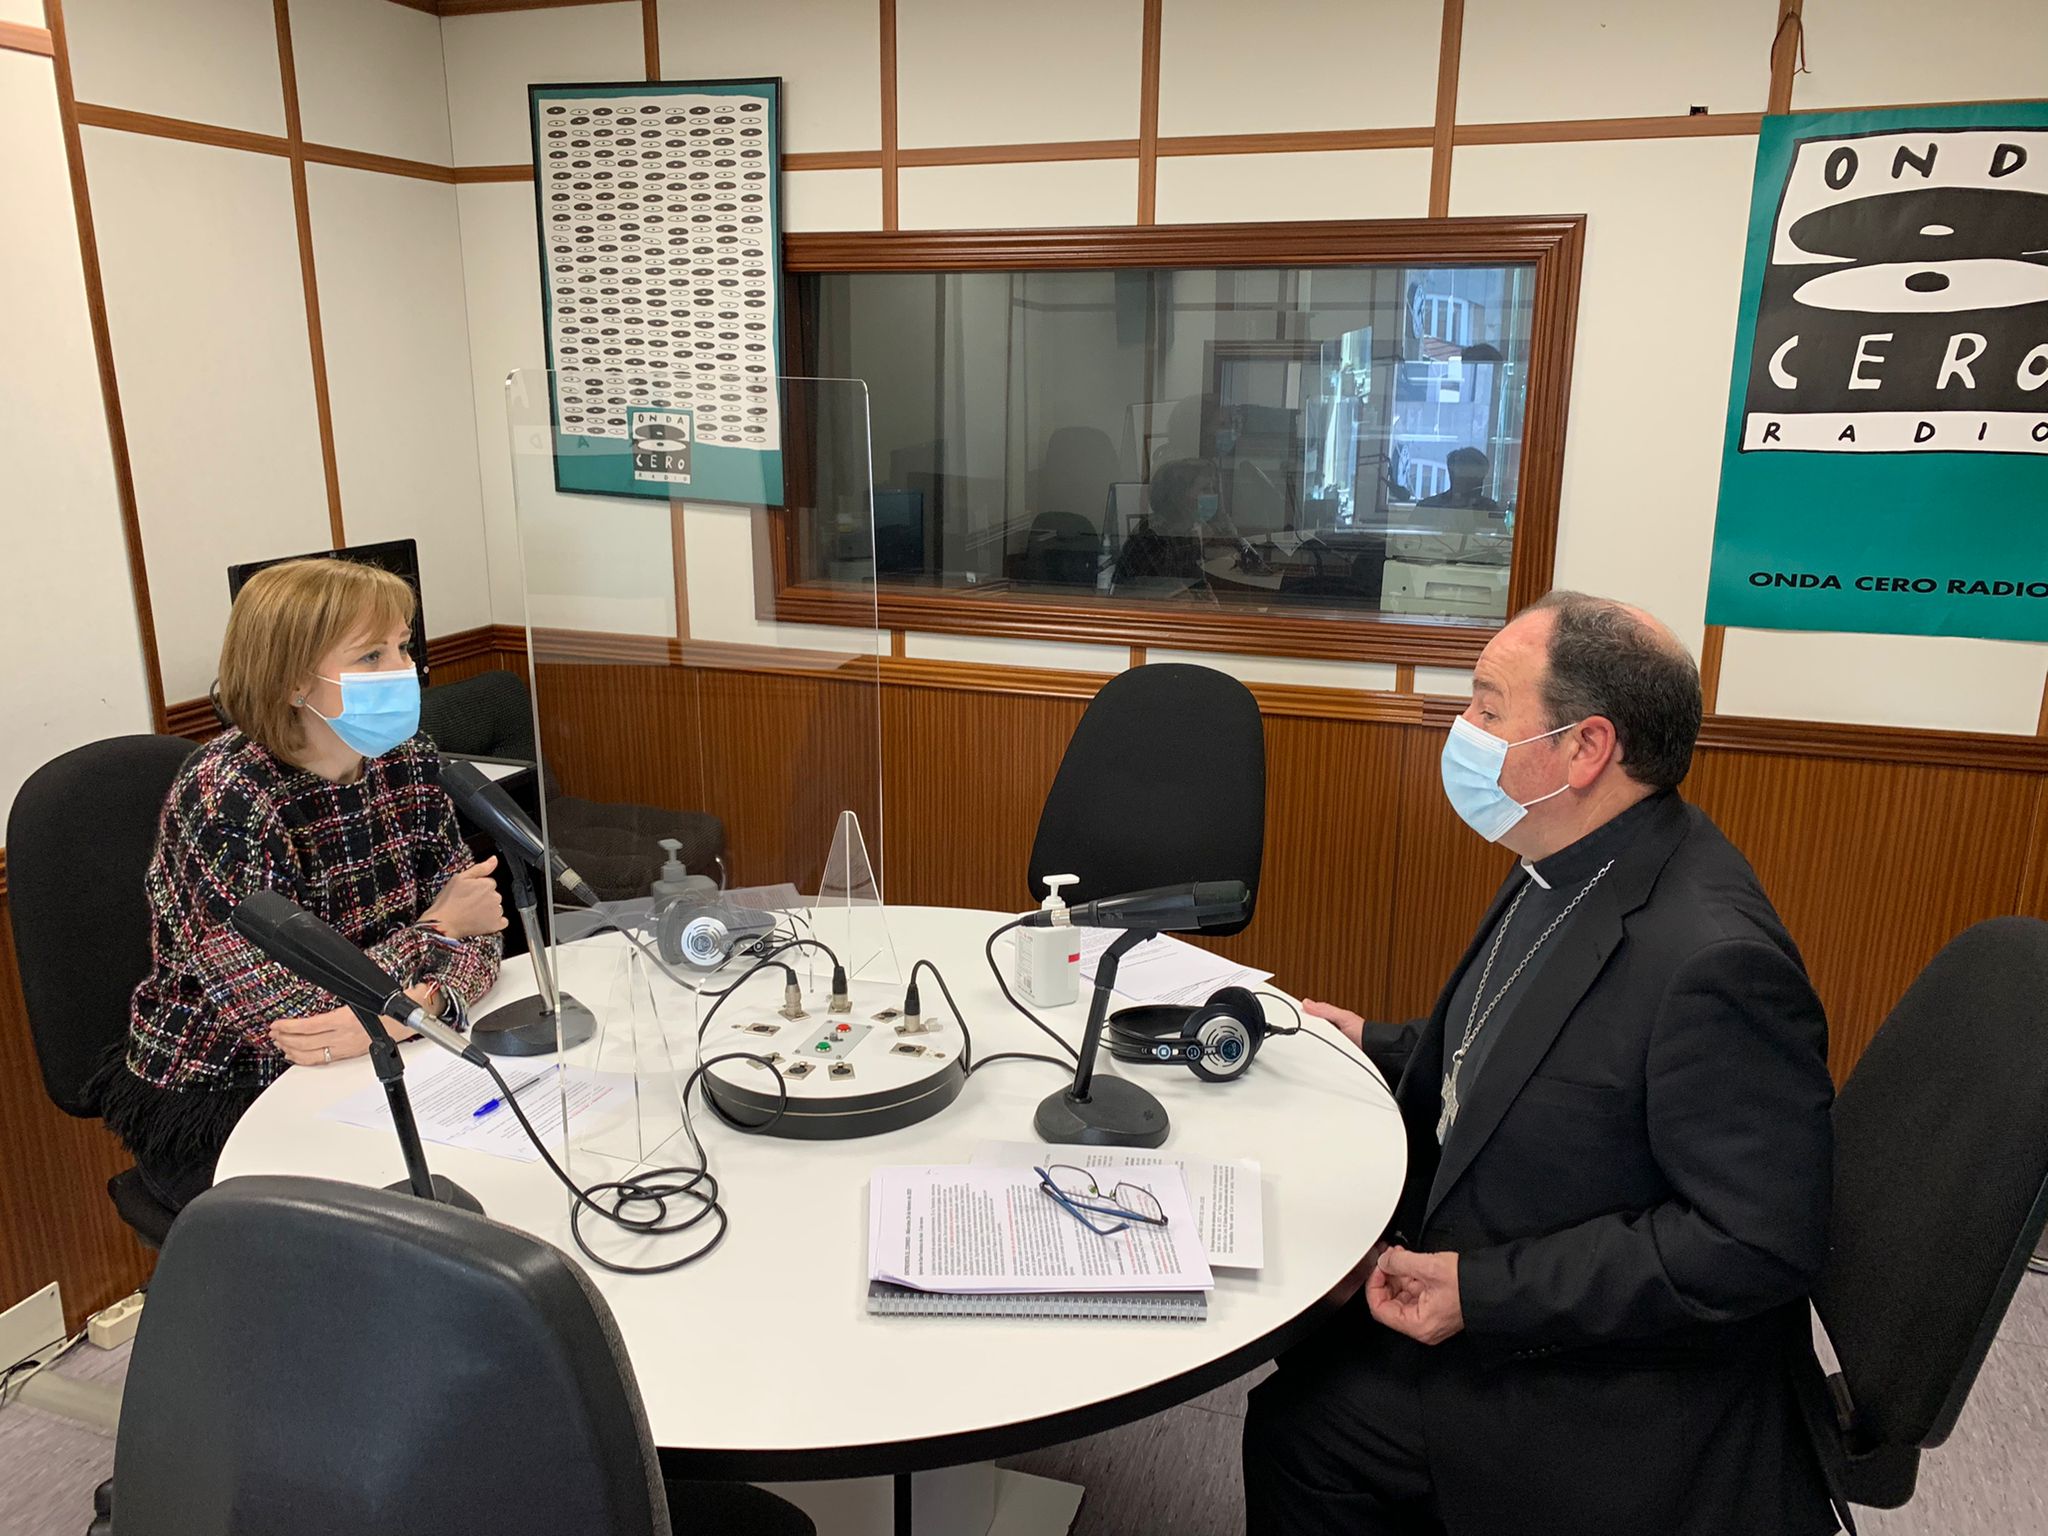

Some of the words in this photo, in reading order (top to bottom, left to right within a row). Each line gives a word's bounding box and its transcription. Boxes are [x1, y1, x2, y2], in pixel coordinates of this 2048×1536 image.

[1824, 143, 2027, 190] OND
[1768, 332, 2048, 391] CERO
[638, 413, 684, 425] ONDA
[1762, 421, 2048, 443] RADIO
[636, 453, 685, 470] CERO
[1748, 572, 1842, 590] ONDA
[1855, 576, 1938, 593] CERO
[1947, 579, 2048, 598] RADIO
